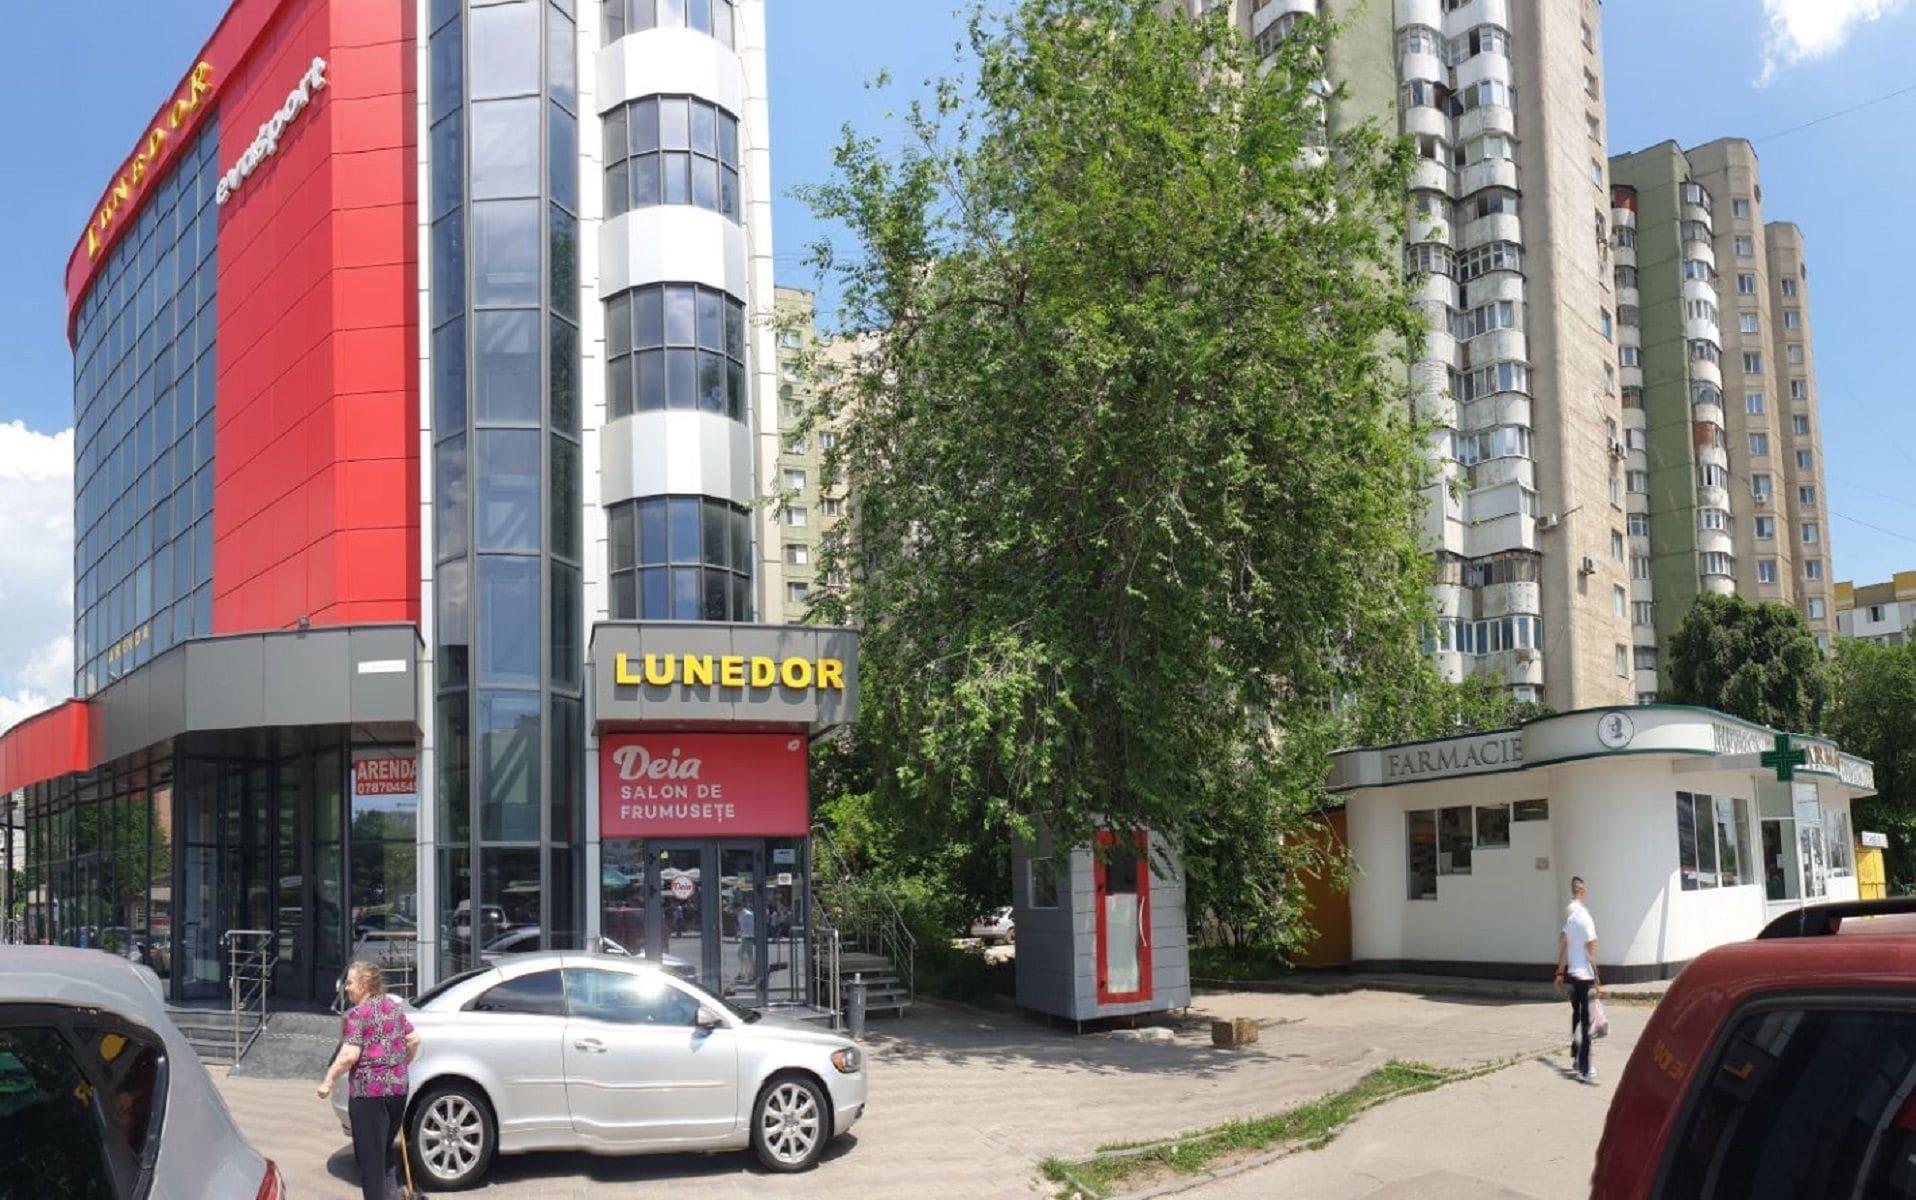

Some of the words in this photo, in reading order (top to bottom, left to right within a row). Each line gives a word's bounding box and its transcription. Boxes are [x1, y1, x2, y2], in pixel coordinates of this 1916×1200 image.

[615, 652, 845, 689] LUNEDOR
[613, 745, 702, 780] Deia
[1388, 738, 1523, 776] FARMACIE
[621, 785, 688, 799] SALON
[697, 784, 722, 799] DE
